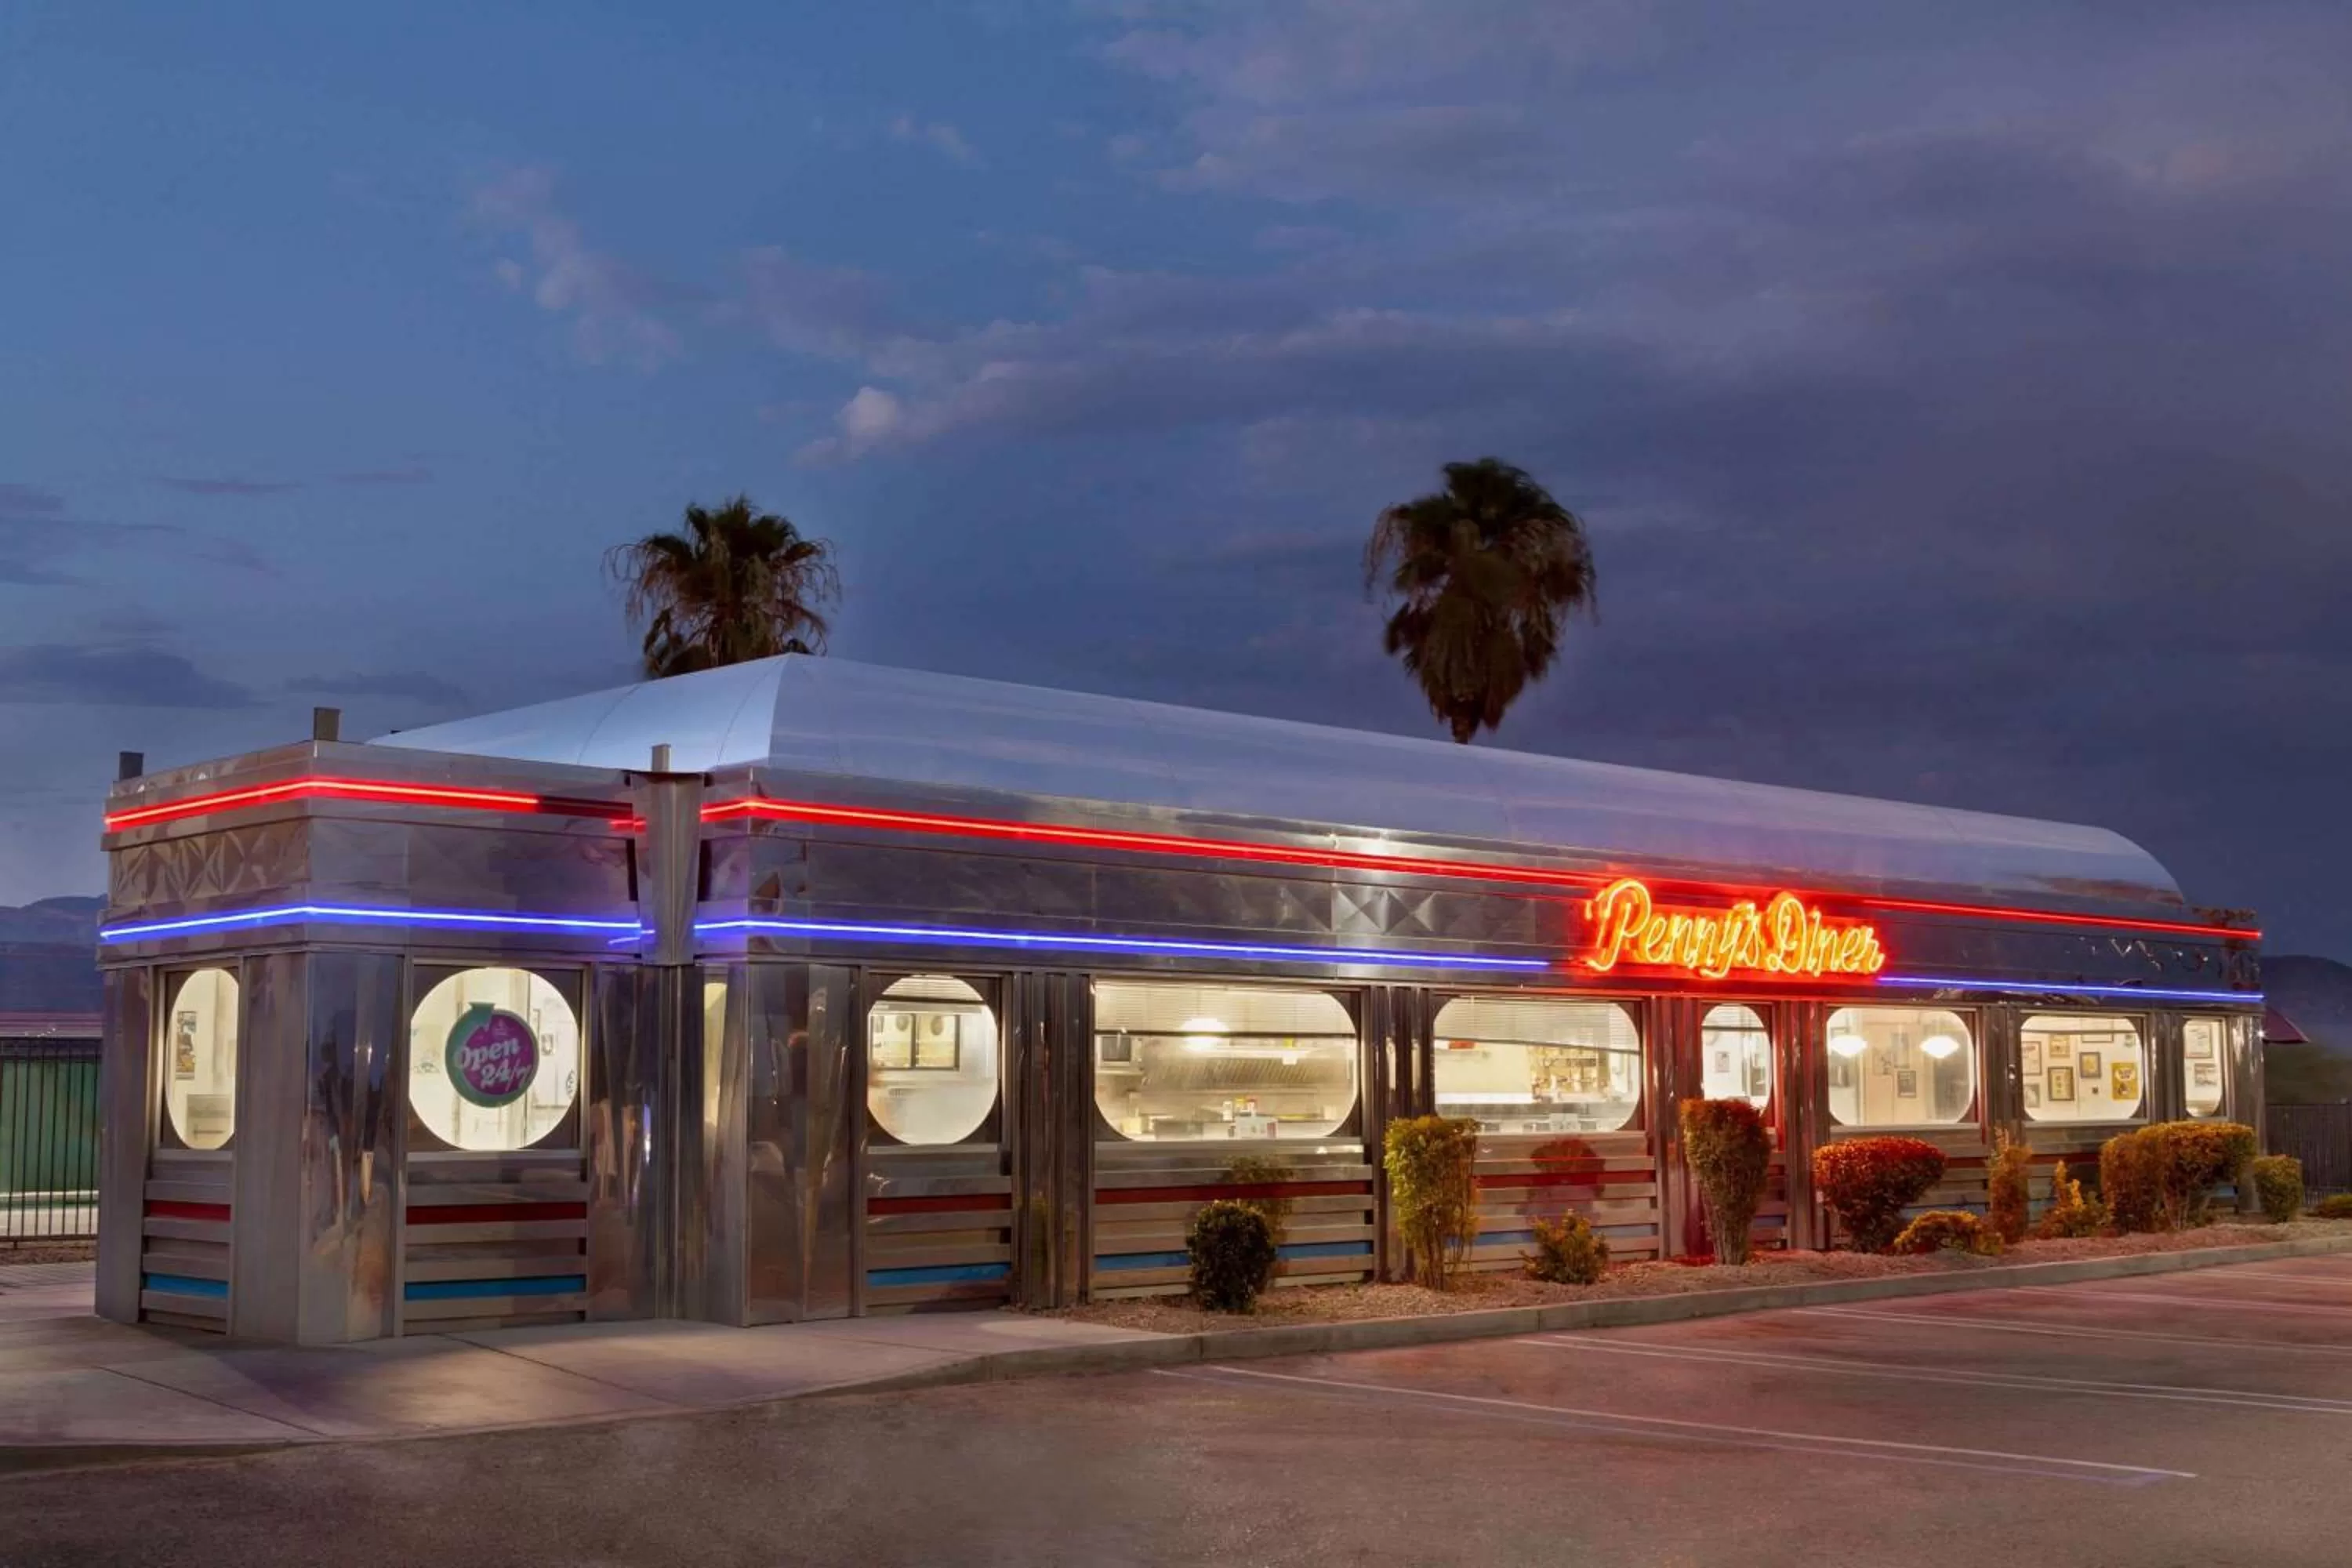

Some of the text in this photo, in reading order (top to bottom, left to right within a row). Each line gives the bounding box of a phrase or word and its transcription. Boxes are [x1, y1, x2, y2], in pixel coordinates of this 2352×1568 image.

[1584, 878, 1886, 979] Penny's Diner
[454, 1037, 521, 1071] Open
[480, 1058, 532, 1091] 24/7
